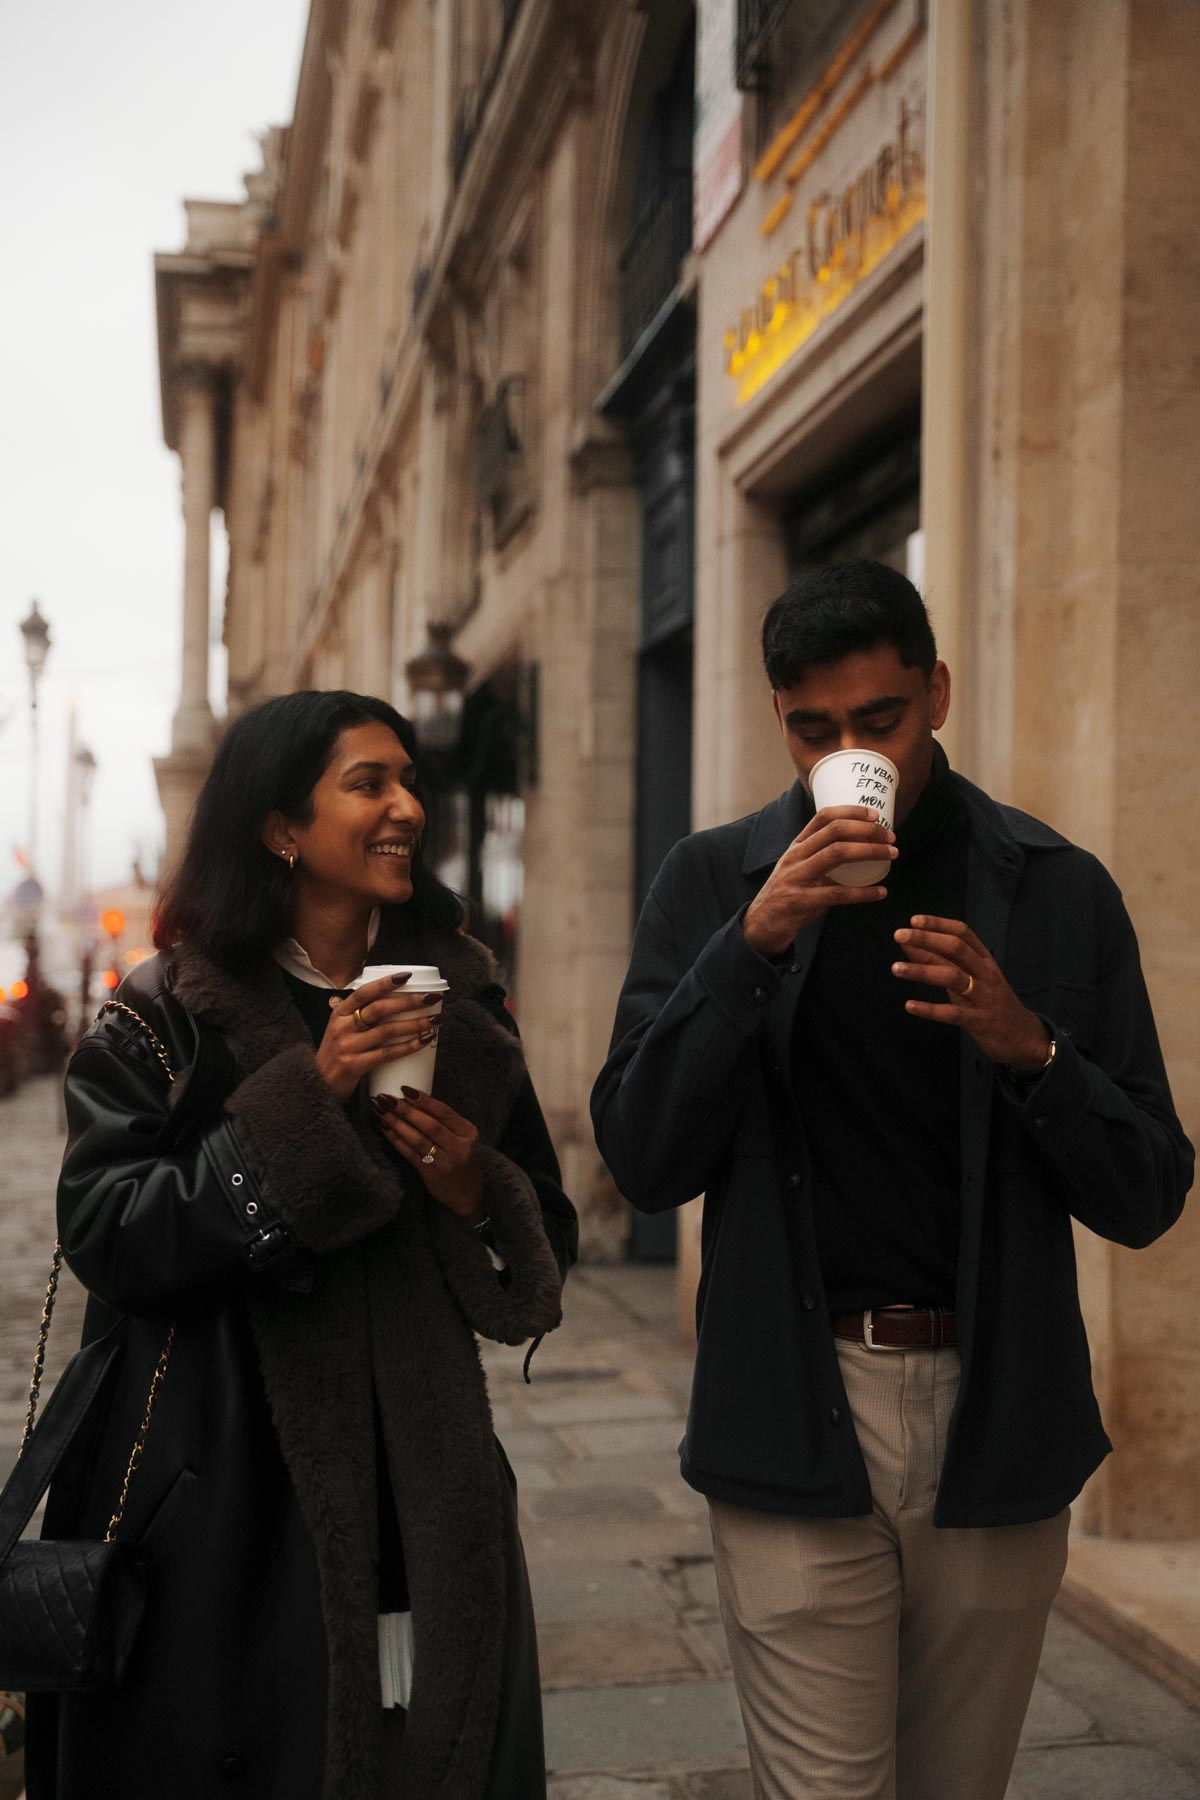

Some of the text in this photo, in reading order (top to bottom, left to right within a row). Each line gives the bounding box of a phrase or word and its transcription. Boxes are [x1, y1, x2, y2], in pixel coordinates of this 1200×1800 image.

[851, 762, 870, 774] TU
[856, 774, 888, 793] ÊTRE
[858, 794, 886, 810] MON
